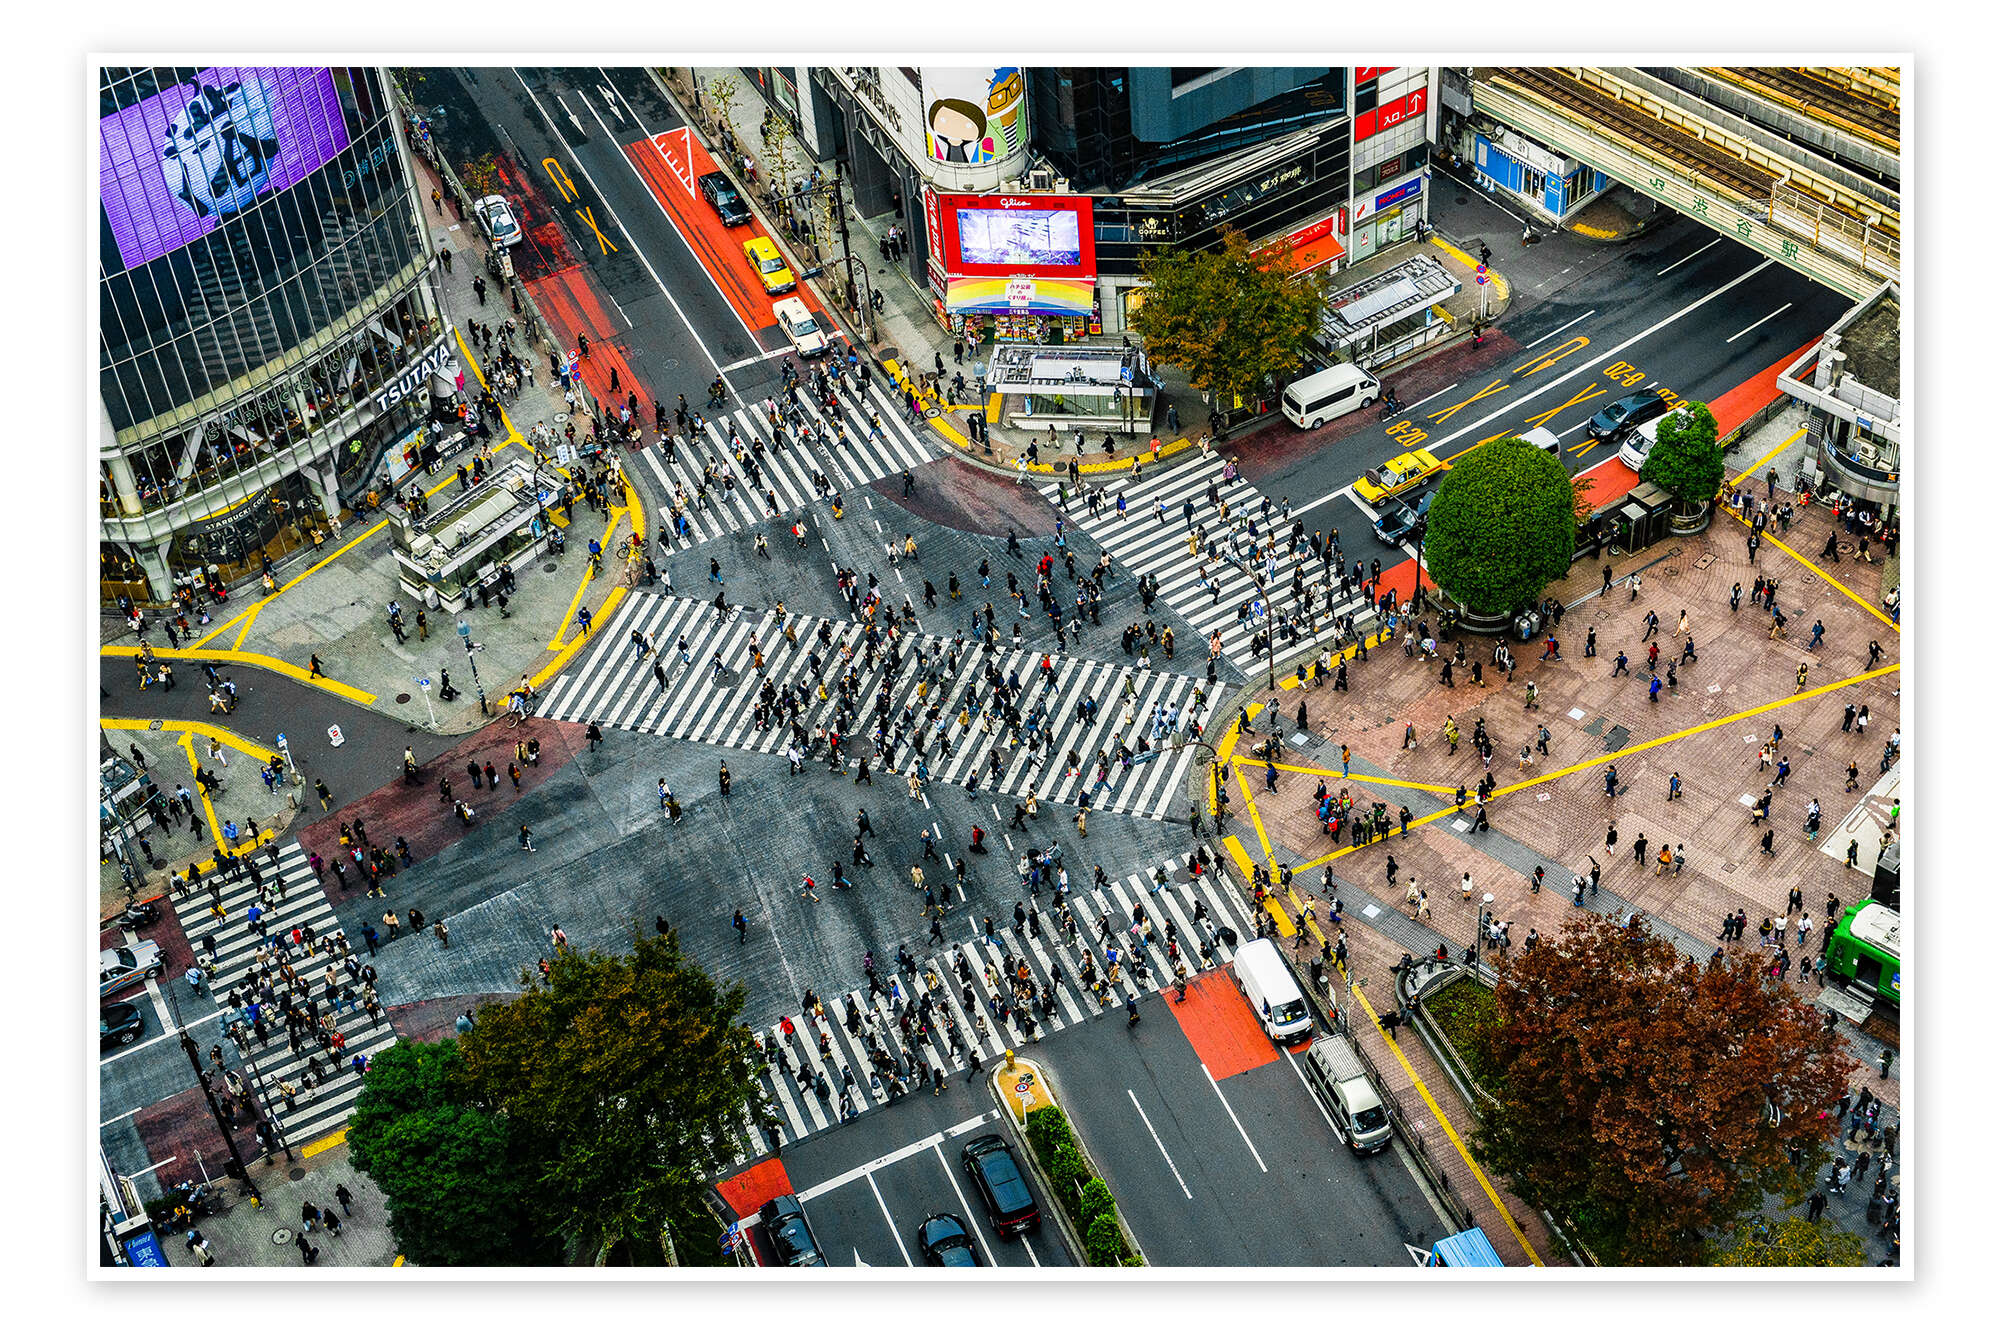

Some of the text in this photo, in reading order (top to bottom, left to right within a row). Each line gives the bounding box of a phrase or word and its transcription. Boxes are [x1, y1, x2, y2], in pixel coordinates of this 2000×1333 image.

[1384, 112, 1400, 126] 入口
[1000, 198, 1031, 208] Glico
[1650, 178, 1799, 260] JR 渋谷駅
[376, 343, 449, 411] TSUTAYA
[1603, 361, 1646, 387] 8-20
[1385, 420, 1428, 447] 8-20
